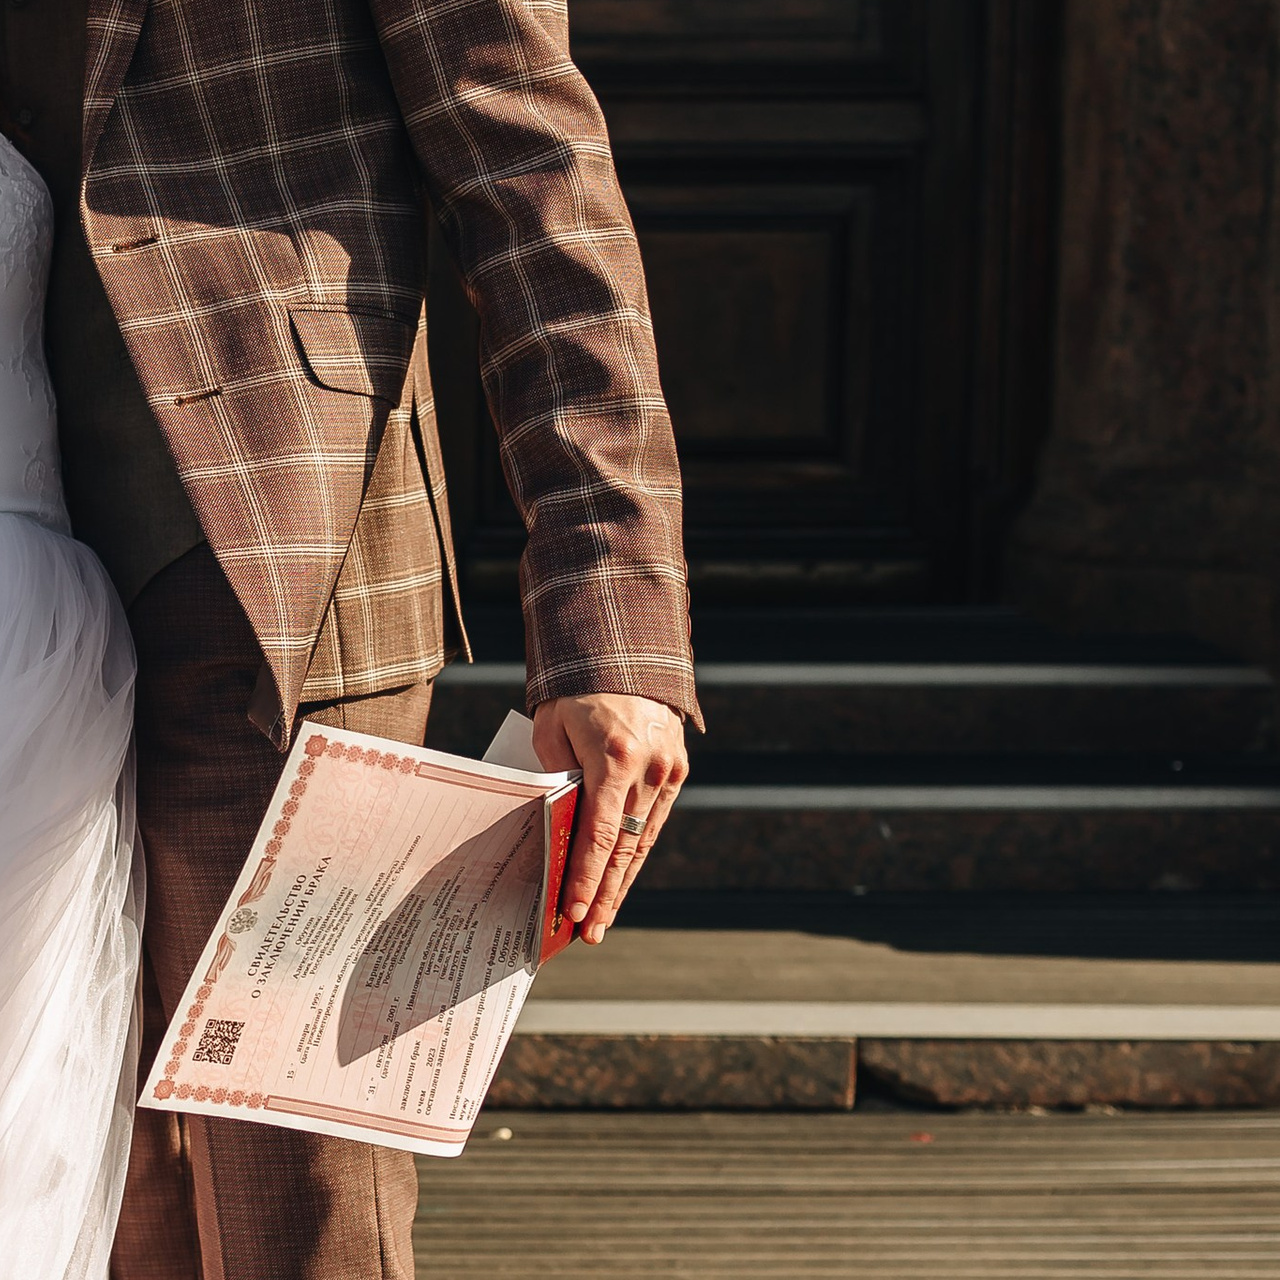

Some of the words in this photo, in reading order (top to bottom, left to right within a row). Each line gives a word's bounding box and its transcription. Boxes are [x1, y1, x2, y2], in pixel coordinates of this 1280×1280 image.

[245, 873, 308, 977] СВИДЕТЕЛЬСТВО
[255, 899, 309, 985] ЗАКЛЮЧЕНИИ
[304, 855, 332, 896] БРАКА
[364, 871, 385, 901] русский
[291, 945, 314, 979] Алексей
[309, 885, 348, 944] Владимирович
[294, 915, 315, 946] Обухов
[308, 932, 335, 975] Российская
[330, 893, 359, 932] Федерация
[364, 955, 383, 988] Карина
[378, 892, 415, 954] Александровна
[381, 939, 405, 985] Российская
[399, 898, 425, 939] Федерация
[435, 932, 452, 963] августа
[446, 913, 459, 932] 2023
[506, 929, 523, 968] Обухова
[295, 1022, 312, 1052] января
[309, 991, 322, 1010] 1995
[311, 984, 340, 1047] Нижегородская
[404, 960, 427, 1011] Ивановская
[416, 1089, 427, 1107] чем
[424, 1047, 437, 1067] 2023
[436, 1003, 447, 1023] года
[445, 949, 462, 981] августа
[462, 902, 479, 930] месяца
[422, 1067, 441, 1115] составлена
[435, 1037, 449, 1067] запись
[442, 1016, 453, 1036] акта
[448, 954, 468, 1007] заключении
[461, 929, 476, 954] брака
[447, 1094, 461, 1119] После
[455, 1042, 475, 1094] заключения
[468, 1016, 481, 1041] брака
[475, 967, 492, 1015] присвоены
[486, 924, 503, 967] фамилии:
[457, 1097, 470, 1121] мужу
[496, 929, 512, 963] Обухов
[374, 1033, 389, 1068] октября
[385, 1004, 398, 1023] 2001
[397, 1061, 416, 1111] заключили
[409, 1039, 422, 1061] брак
